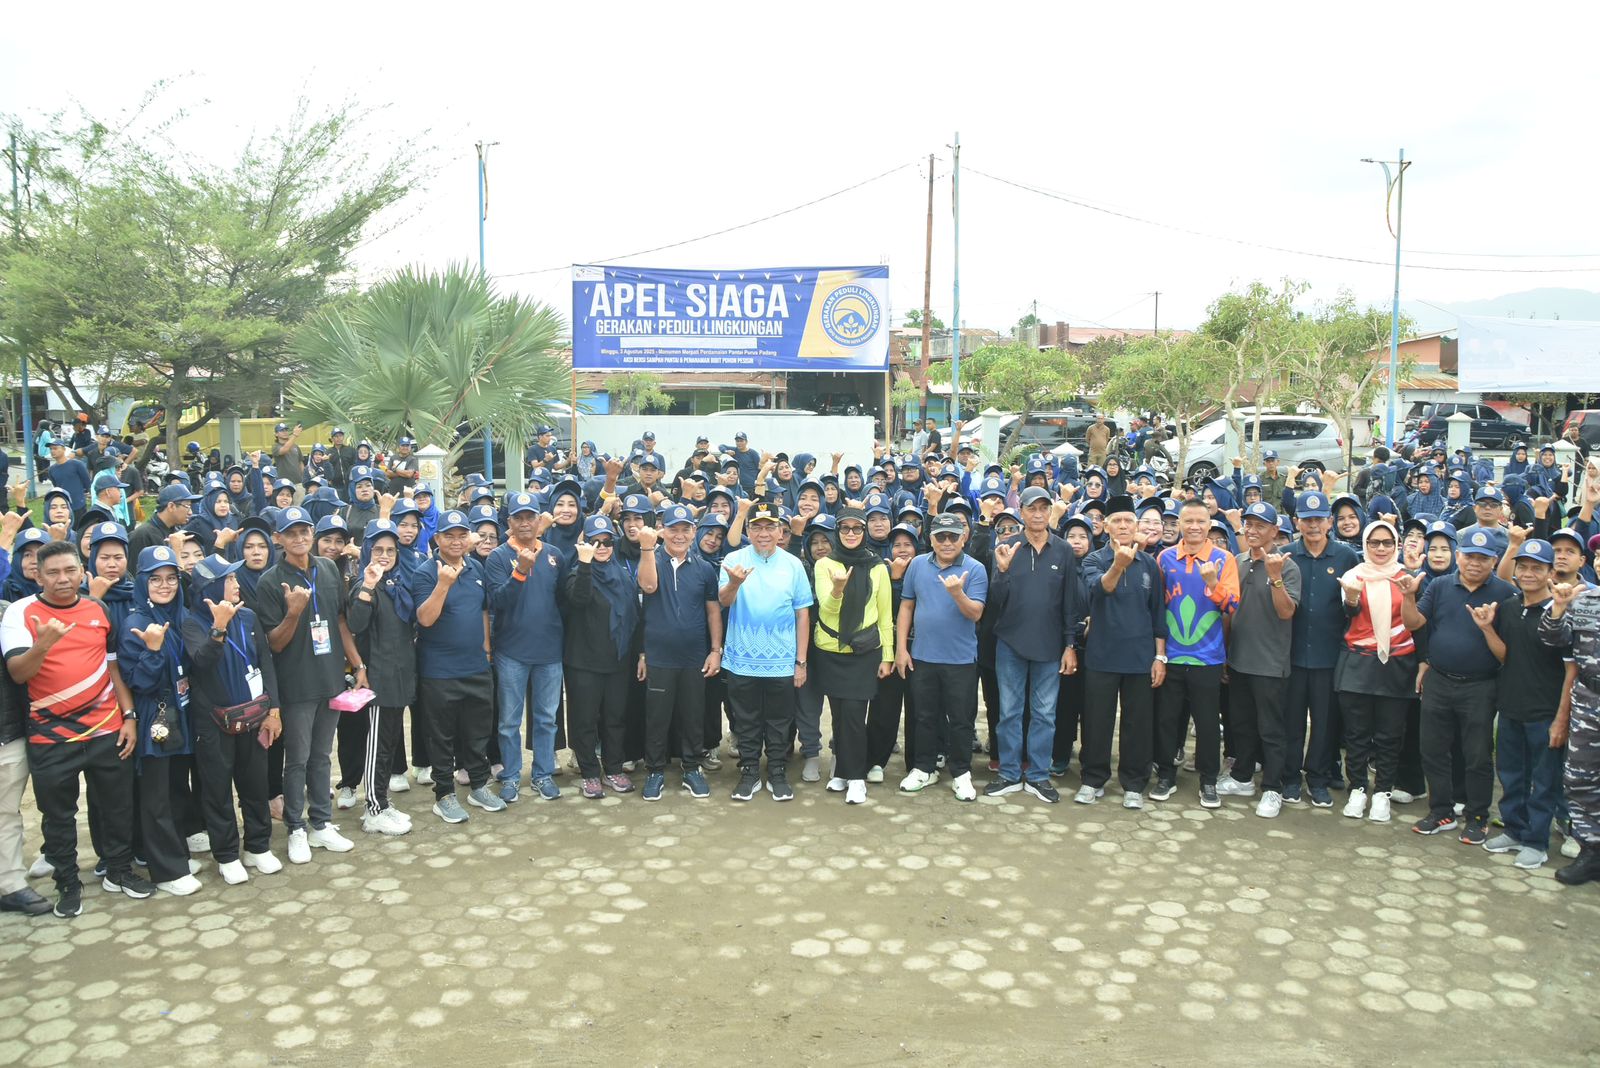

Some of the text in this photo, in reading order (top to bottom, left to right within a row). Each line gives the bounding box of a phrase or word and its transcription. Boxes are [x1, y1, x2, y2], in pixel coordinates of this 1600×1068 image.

[590, 283, 790, 318] APEL SIAGA
[823, 287, 880, 330] GERAKAN PEDULI LINGKUNGAN
[596, 319, 783, 335] GERAKAN PEDULI LINGKUNGAN
